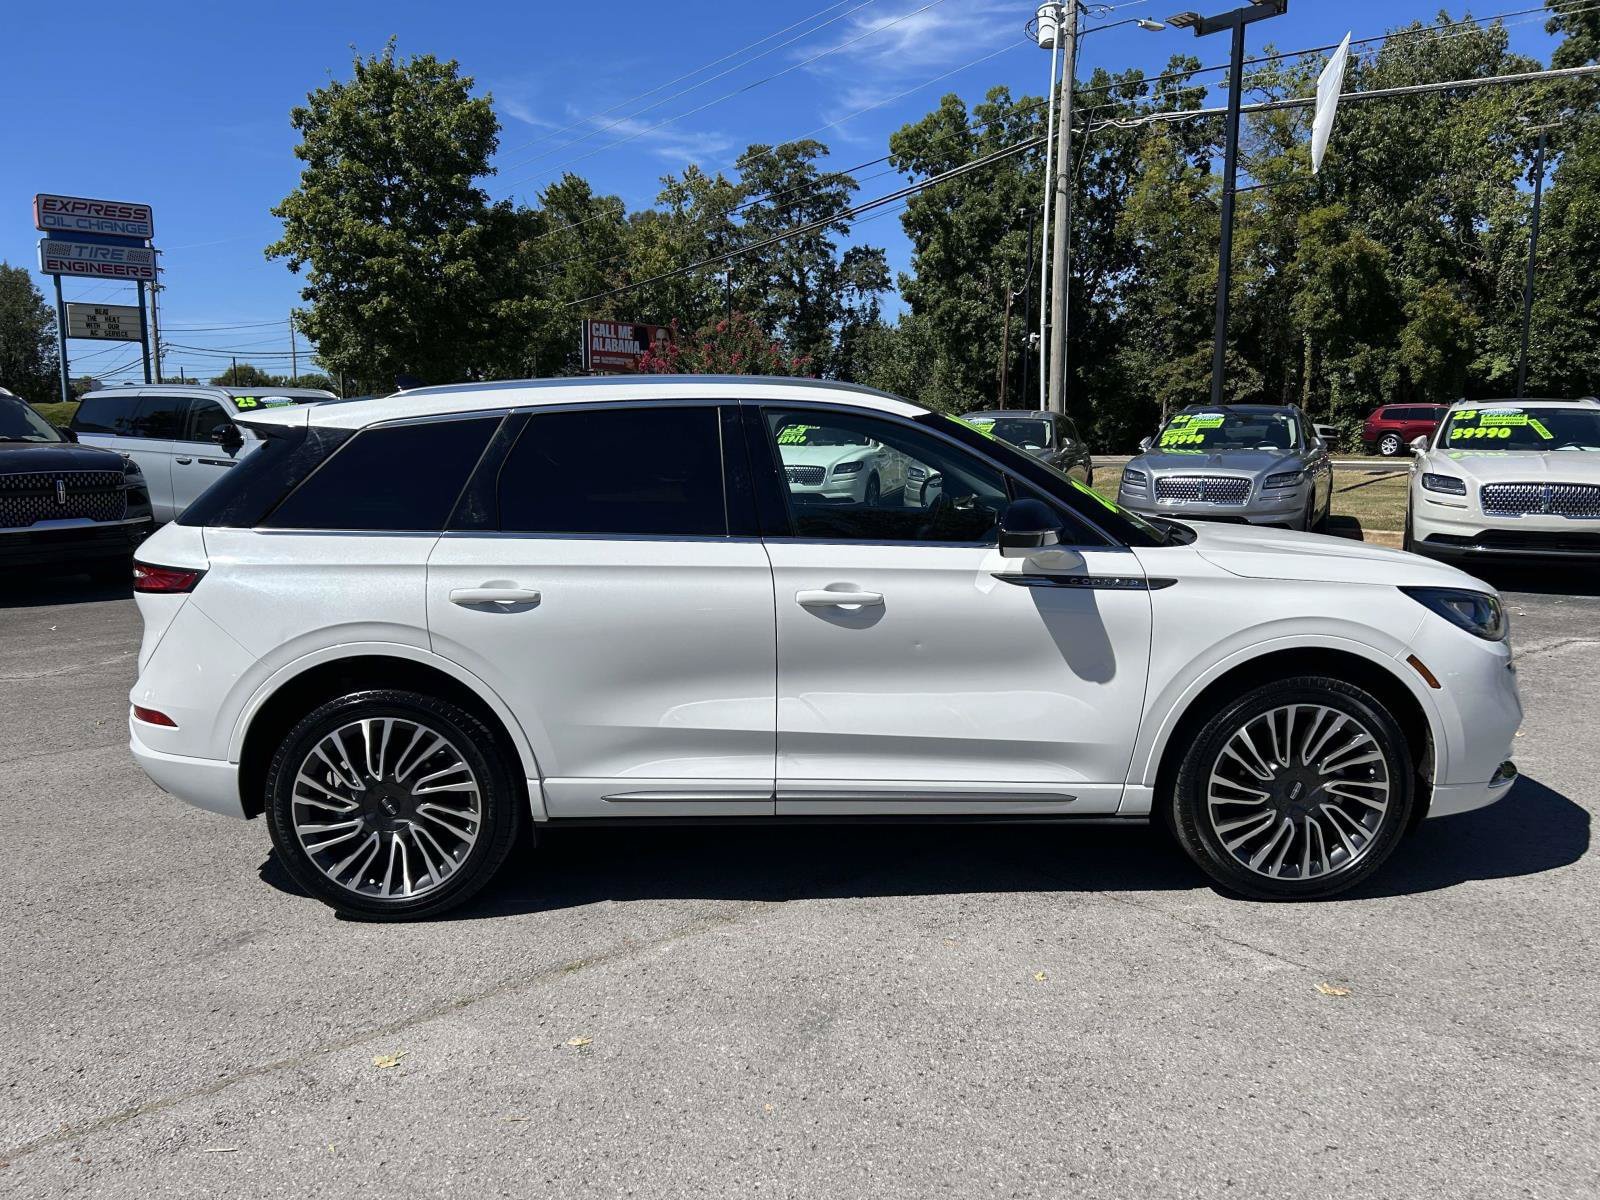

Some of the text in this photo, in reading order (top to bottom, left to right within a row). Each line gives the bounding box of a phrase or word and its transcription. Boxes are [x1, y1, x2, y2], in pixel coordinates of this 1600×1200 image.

[43, 199, 148, 220] EXPRESS
[43, 215, 148, 235] OIL CHANGE
[74, 245, 124, 260] TIRE
[46, 259, 153, 277] ENGINEERS
[592, 323, 633, 339] CALL ME
[234, 397, 257, 408] 25
[1171, 415, 1191, 423] 22
[1453, 410, 1477, 419] 23
[1451, 427, 1511, 439] 39990
